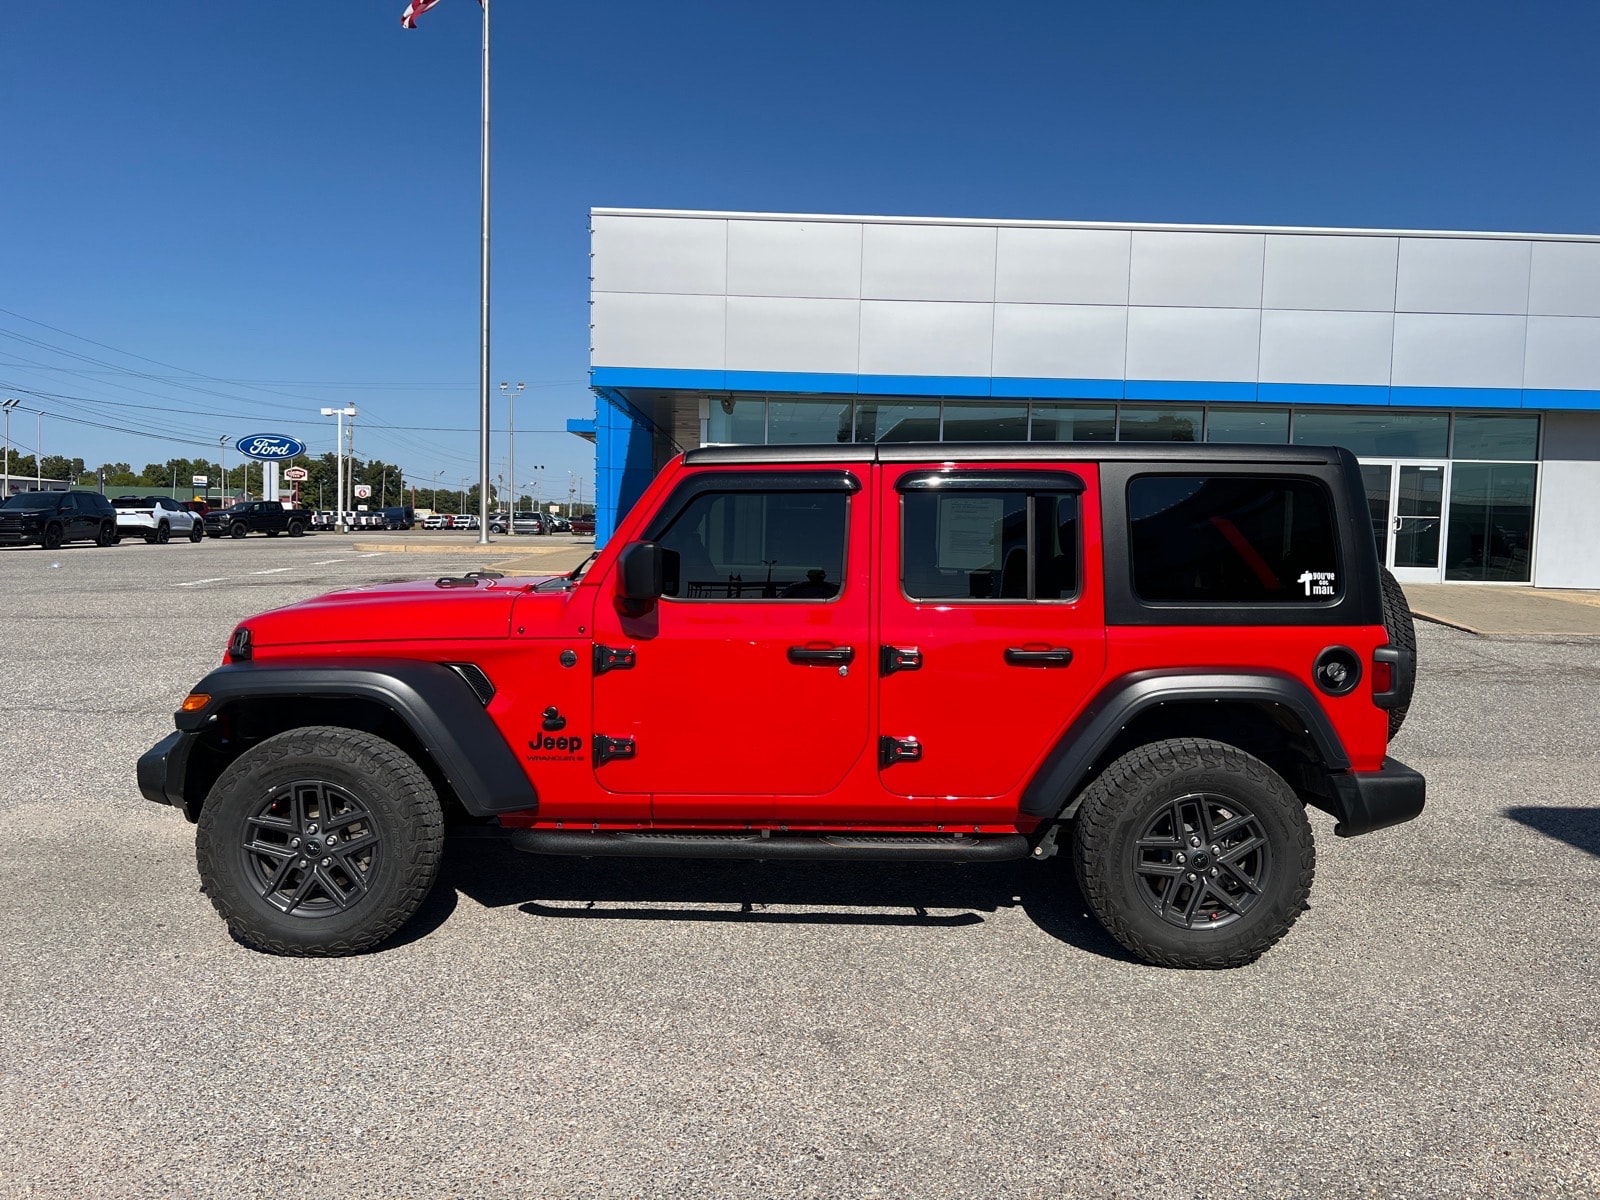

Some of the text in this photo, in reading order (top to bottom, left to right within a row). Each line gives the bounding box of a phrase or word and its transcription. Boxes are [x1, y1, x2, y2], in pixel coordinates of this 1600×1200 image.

[249, 438, 290, 455] Ford
[1312, 586, 1335, 595] mail
[528, 732, 582, 754] Jeep
[1132, 773, 1216, 816] COOPER
[357, 778, 404, 859] COOPER
